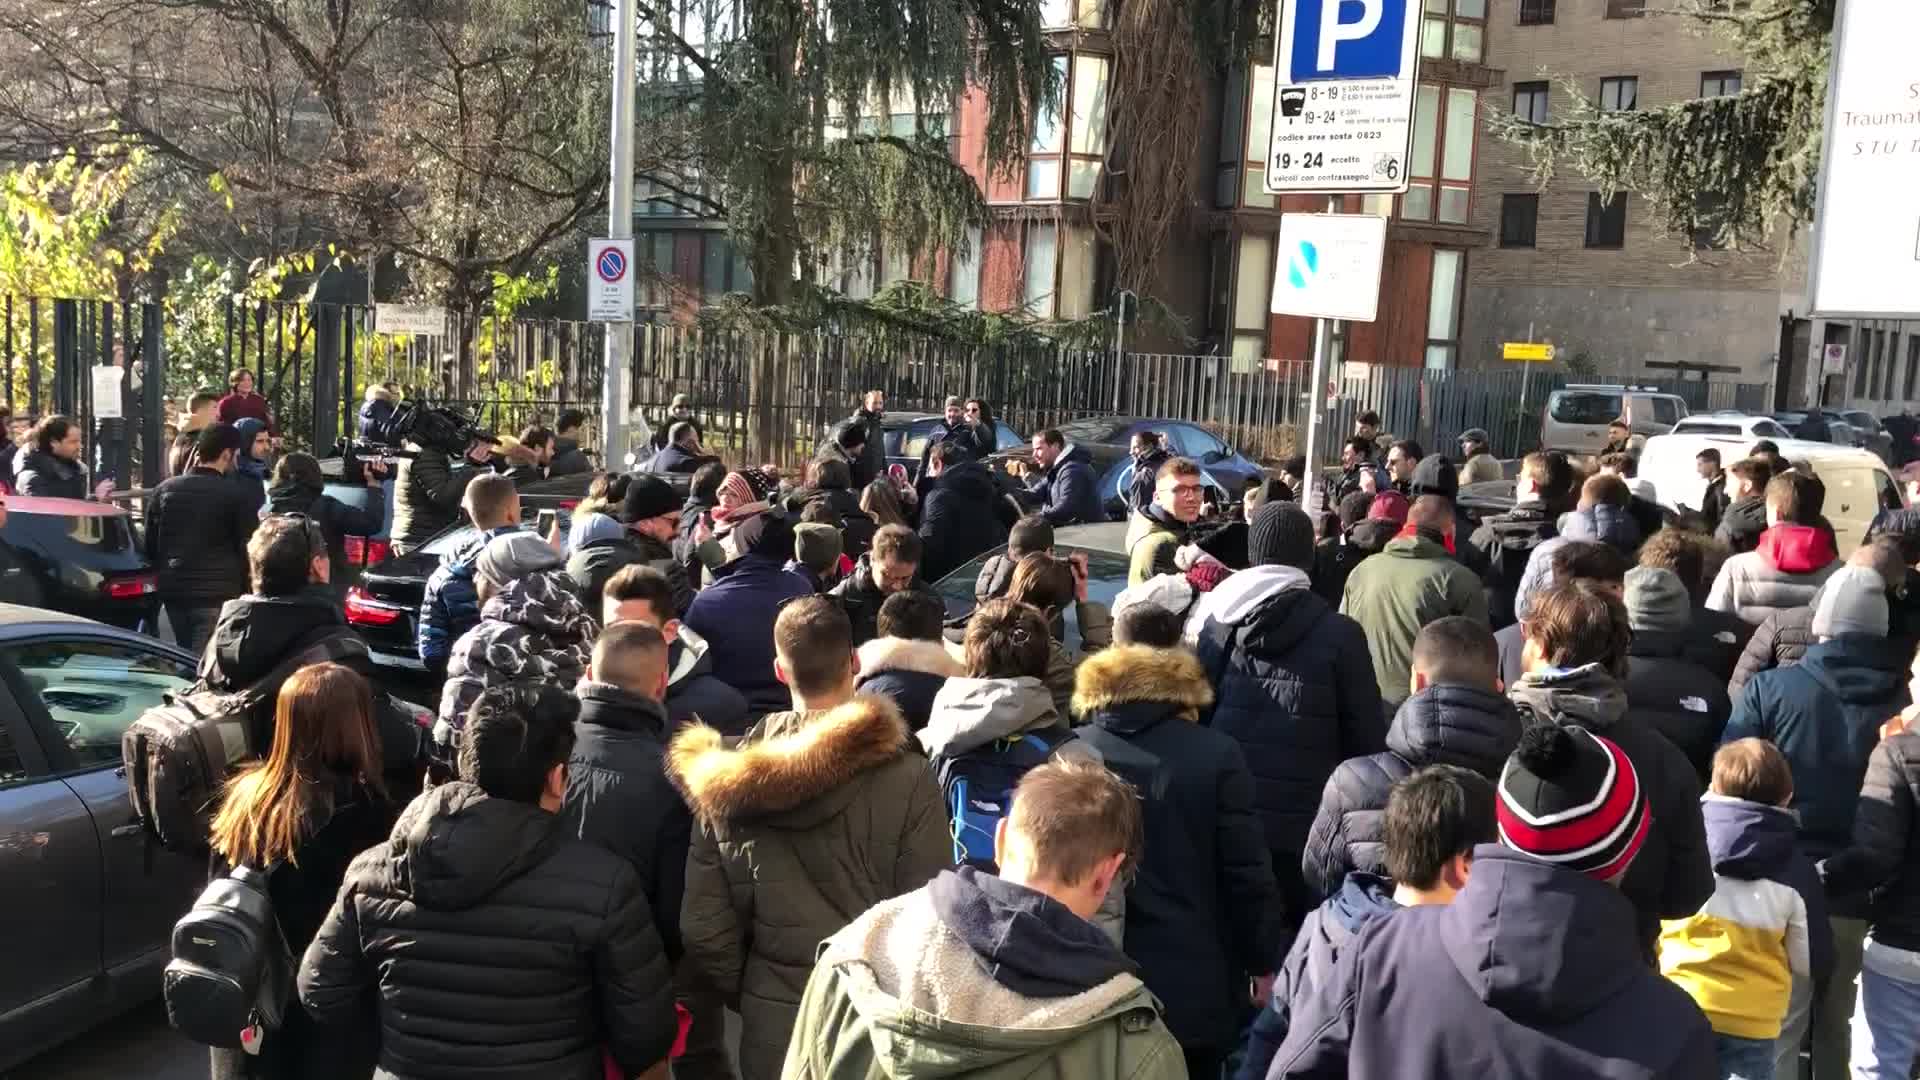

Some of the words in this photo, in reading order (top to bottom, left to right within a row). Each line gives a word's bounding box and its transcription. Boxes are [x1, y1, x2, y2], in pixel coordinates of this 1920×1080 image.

[1316, 0, 1384, 72] P
[1278, 133, 1304, 142] codice
[1330, 132, 1352, 140] sosta
[1330, 155, 1360, 163] eccetto
[1387, 157, 1398, 179] 6
[1318, 173, 1369, 182] contrassegno
